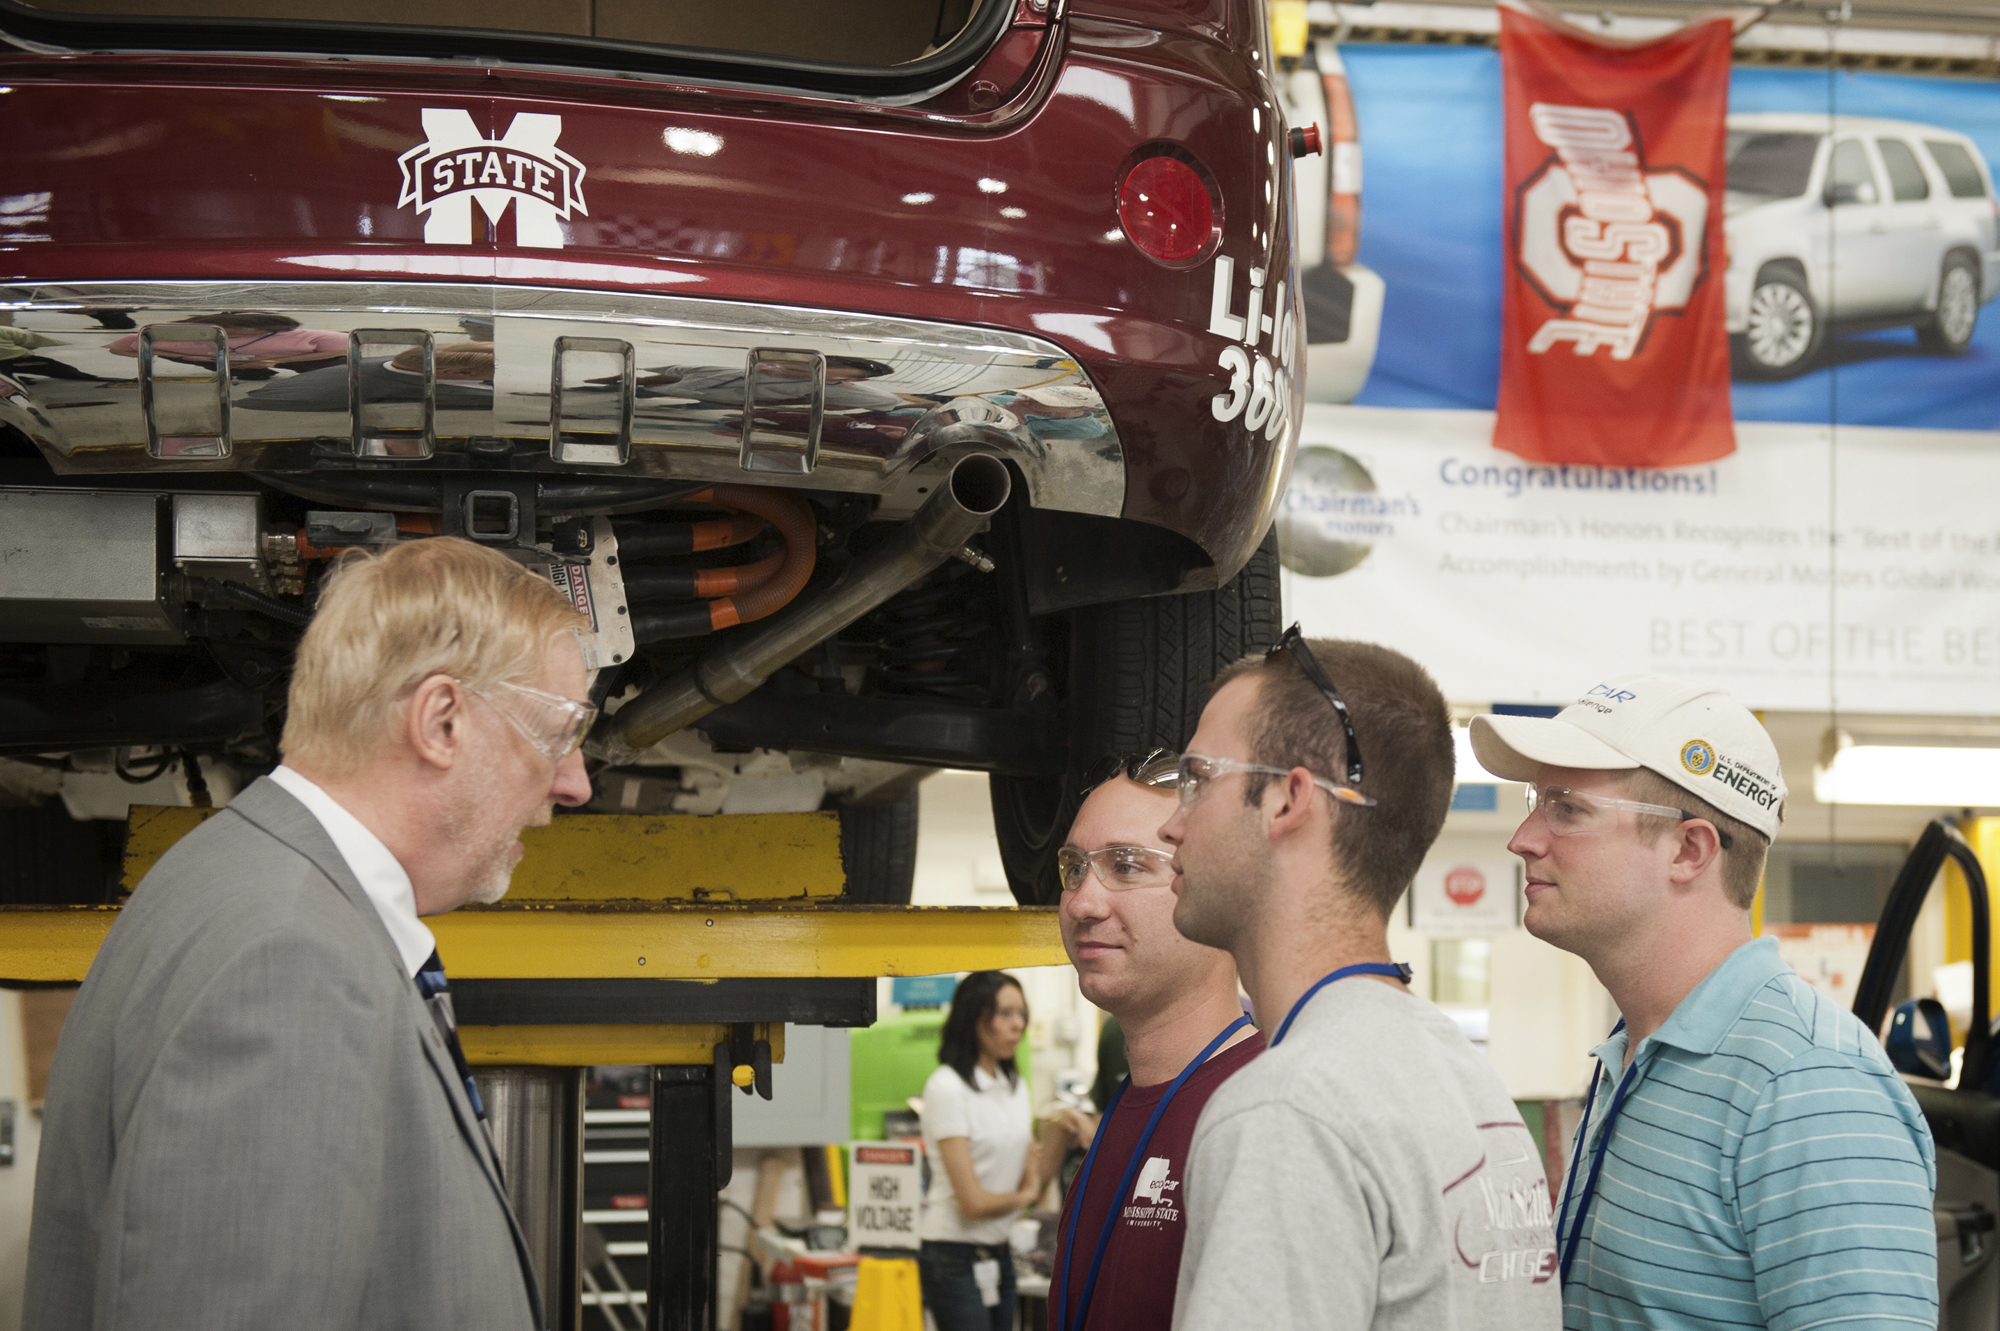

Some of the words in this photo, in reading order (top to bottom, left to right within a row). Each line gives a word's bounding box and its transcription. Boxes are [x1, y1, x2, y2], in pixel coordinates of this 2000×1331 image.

[433, 151, 555, 201] STATE
[1211, 345, 1292, 440] 360
[1438, 457, 1718, 497] Congratulations!
[1437, 510, 1573, 538] Chairman's
[1579, 515, 1666, 540] Honors
[1673, 520, 1801, 550] Recognizes
[1920, 528, 1945, 551] of
[1951, 531, 1989, 554] the
[572, 565, 589, 614] DANGE
[1438, 551, 1653, 582] Accomplishments
[1657, 560, 1685, 586] by
[1692, 560, 1784, 585] General
[1881, 566, 1956, 590] Global
[1649, 617, 1752, 659] BEST
[1768, 620, 1828, 661] OF
[1840, 623, 1925, 665] THE
[1712, 762, 1778, 810] ENERGY
[1719, 754, 1732, 766] U.S.
[1734, 762, 1770, 786] DEPARTMENT
[868, 1175, 900, 1200] HIGH
[1149, 1179, 1179, 1191] ecocar
[855, 1205, 913, 1233] VOLTAGE
[1155, 1207, 1179, 1221] STATE
